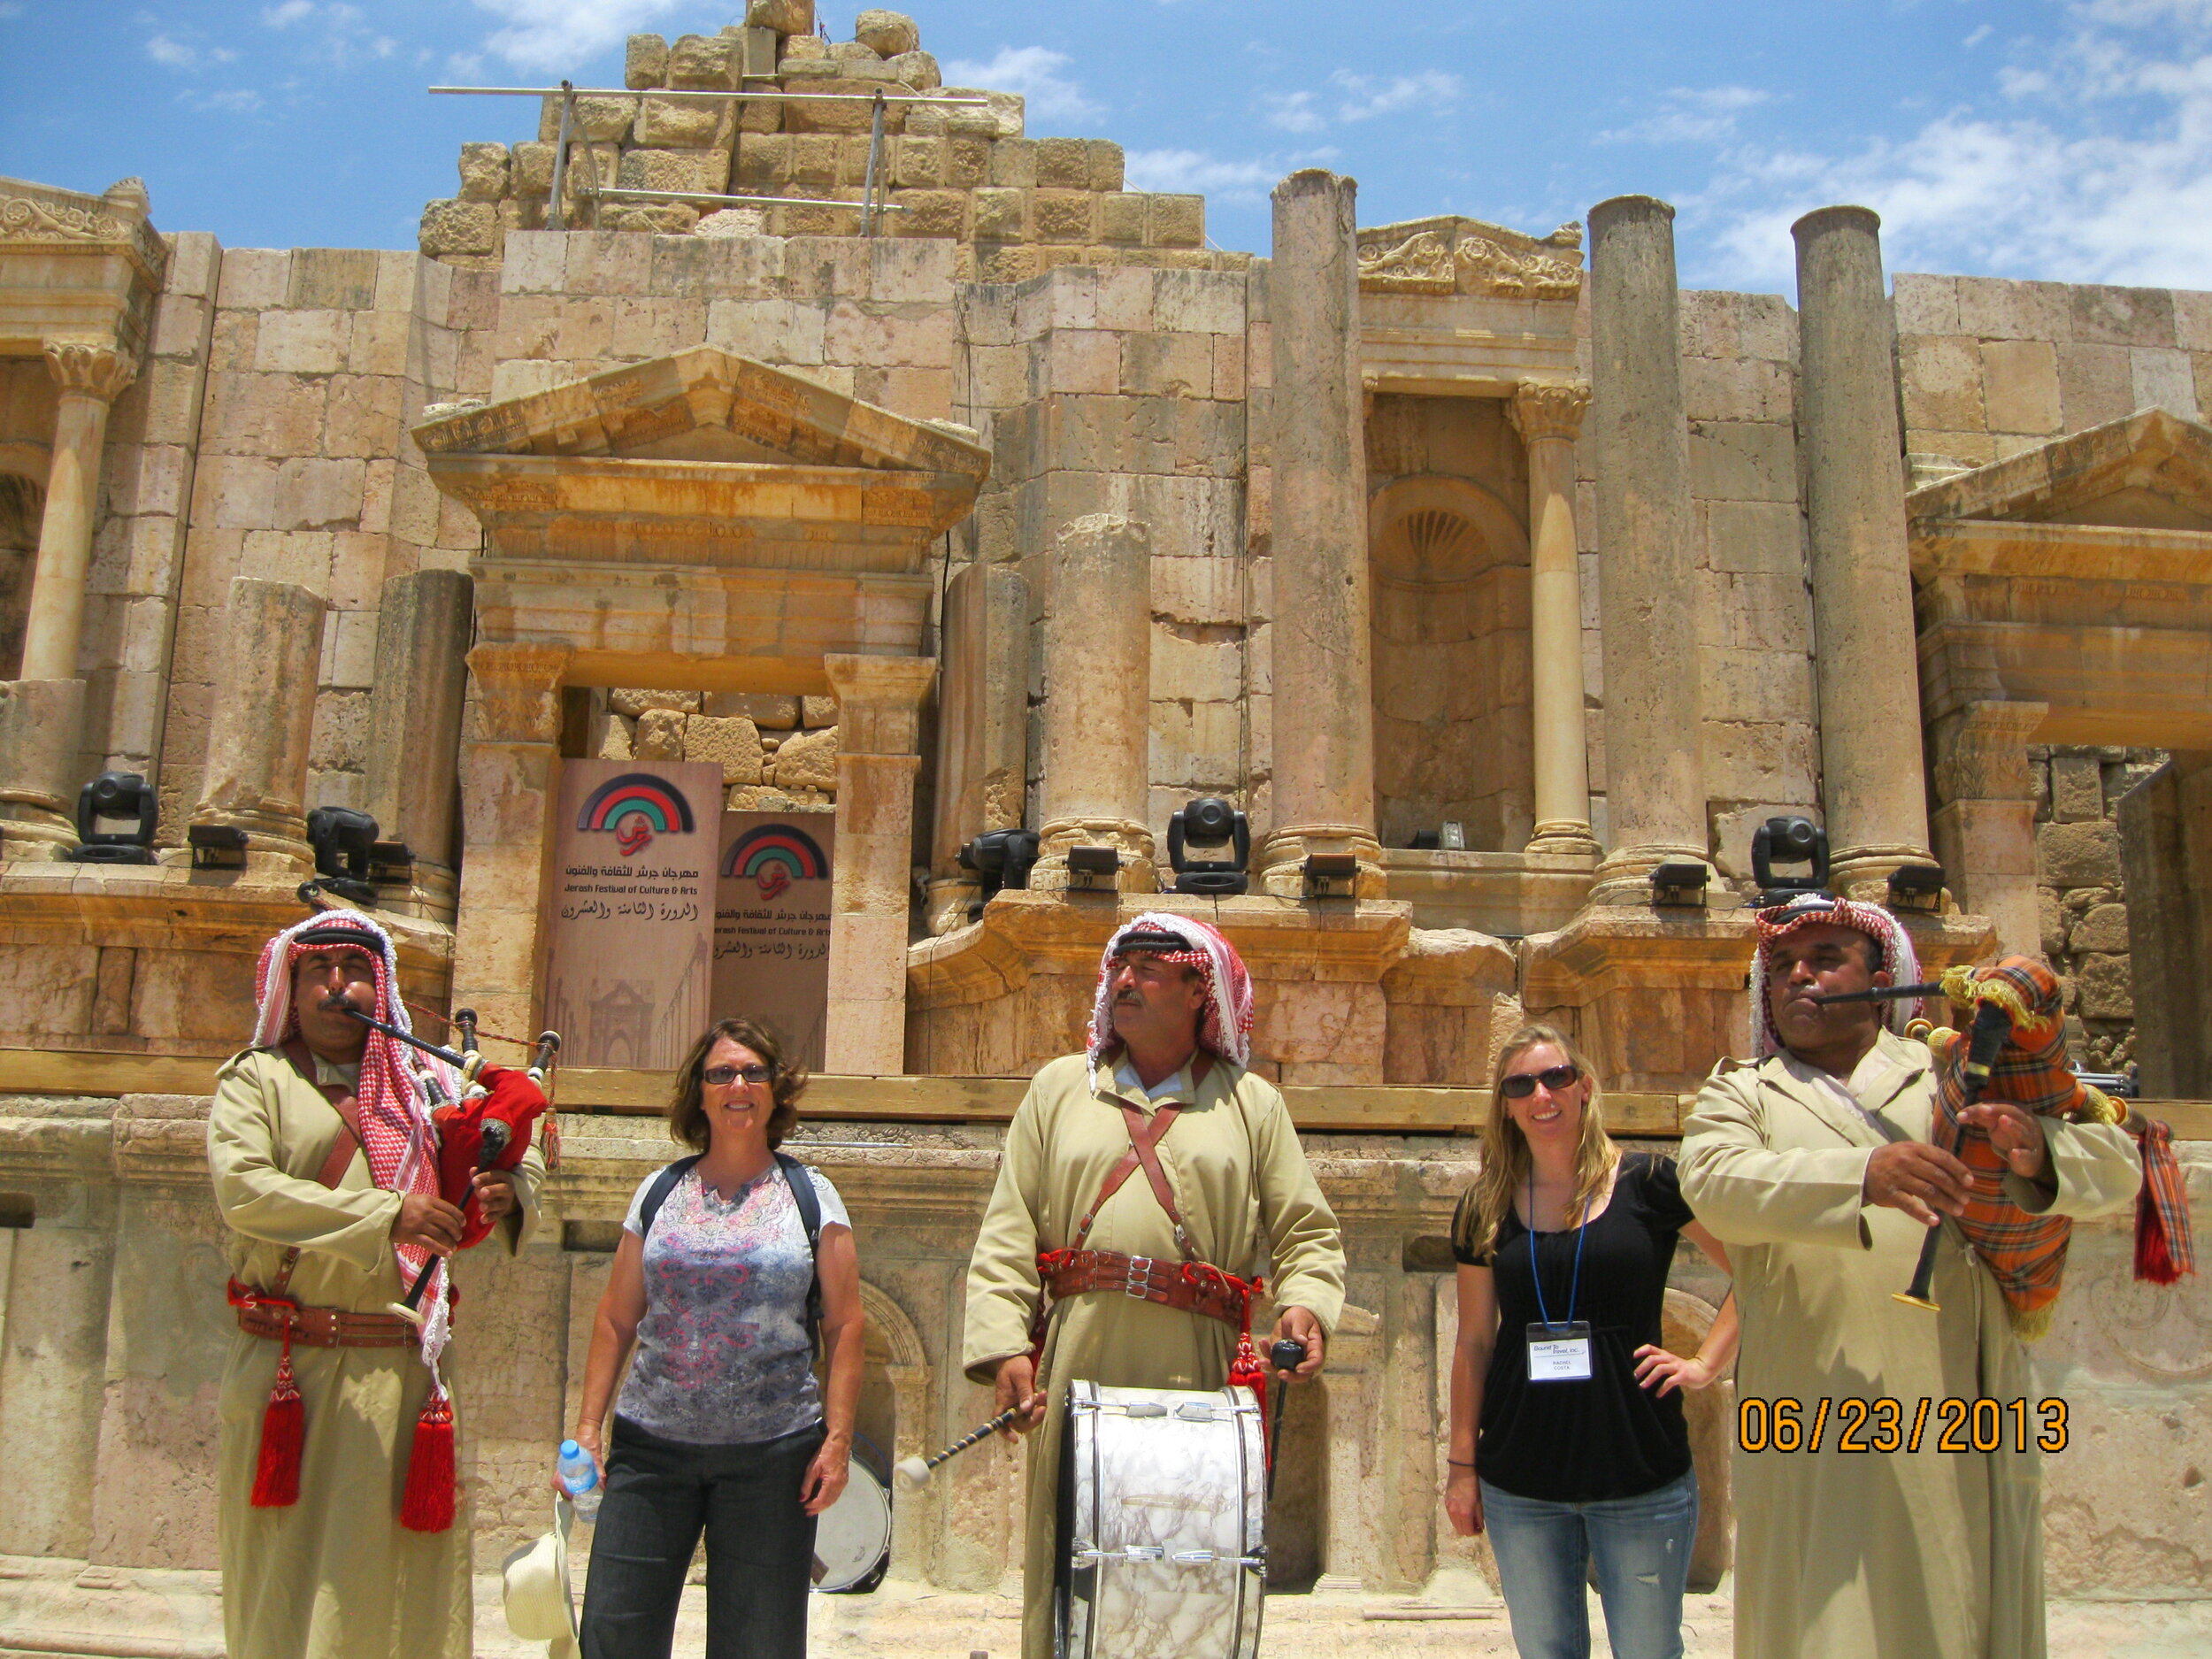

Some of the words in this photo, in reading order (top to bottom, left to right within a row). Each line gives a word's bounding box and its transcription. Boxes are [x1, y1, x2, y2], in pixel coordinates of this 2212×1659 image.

[565, 864, 598, 878] والفنون
[601, 864, 633, 877] للثقافة
[635, 865, 659, 879] جرش
[663, 866, 699, 880] مهرجان
[565, 884, 593, 893] Jerash
[595, 884, 626, 894] Festival
[627, 885, 637, 894] of
[639, 886, 670, 895] Culture
[680, 887, 698, 895] Arts
[560, 900, 611, 920] والعشرون
[618, 901, 655, 920] الثامنة
[660, 902, 699, 921] الدورة
[715, 909, 741, 920] والفنو
[742, 908, 772, 919] للثقافة
[775, 908, 797, 922] جرش
[738, 926, 766, 935] Festival
[779, 927, 807, 936] Culture
[808, 927, 815, 936] &
[713, 941, 753, 960] والعشرو
[758, 941, 793, 960] الثامنة
